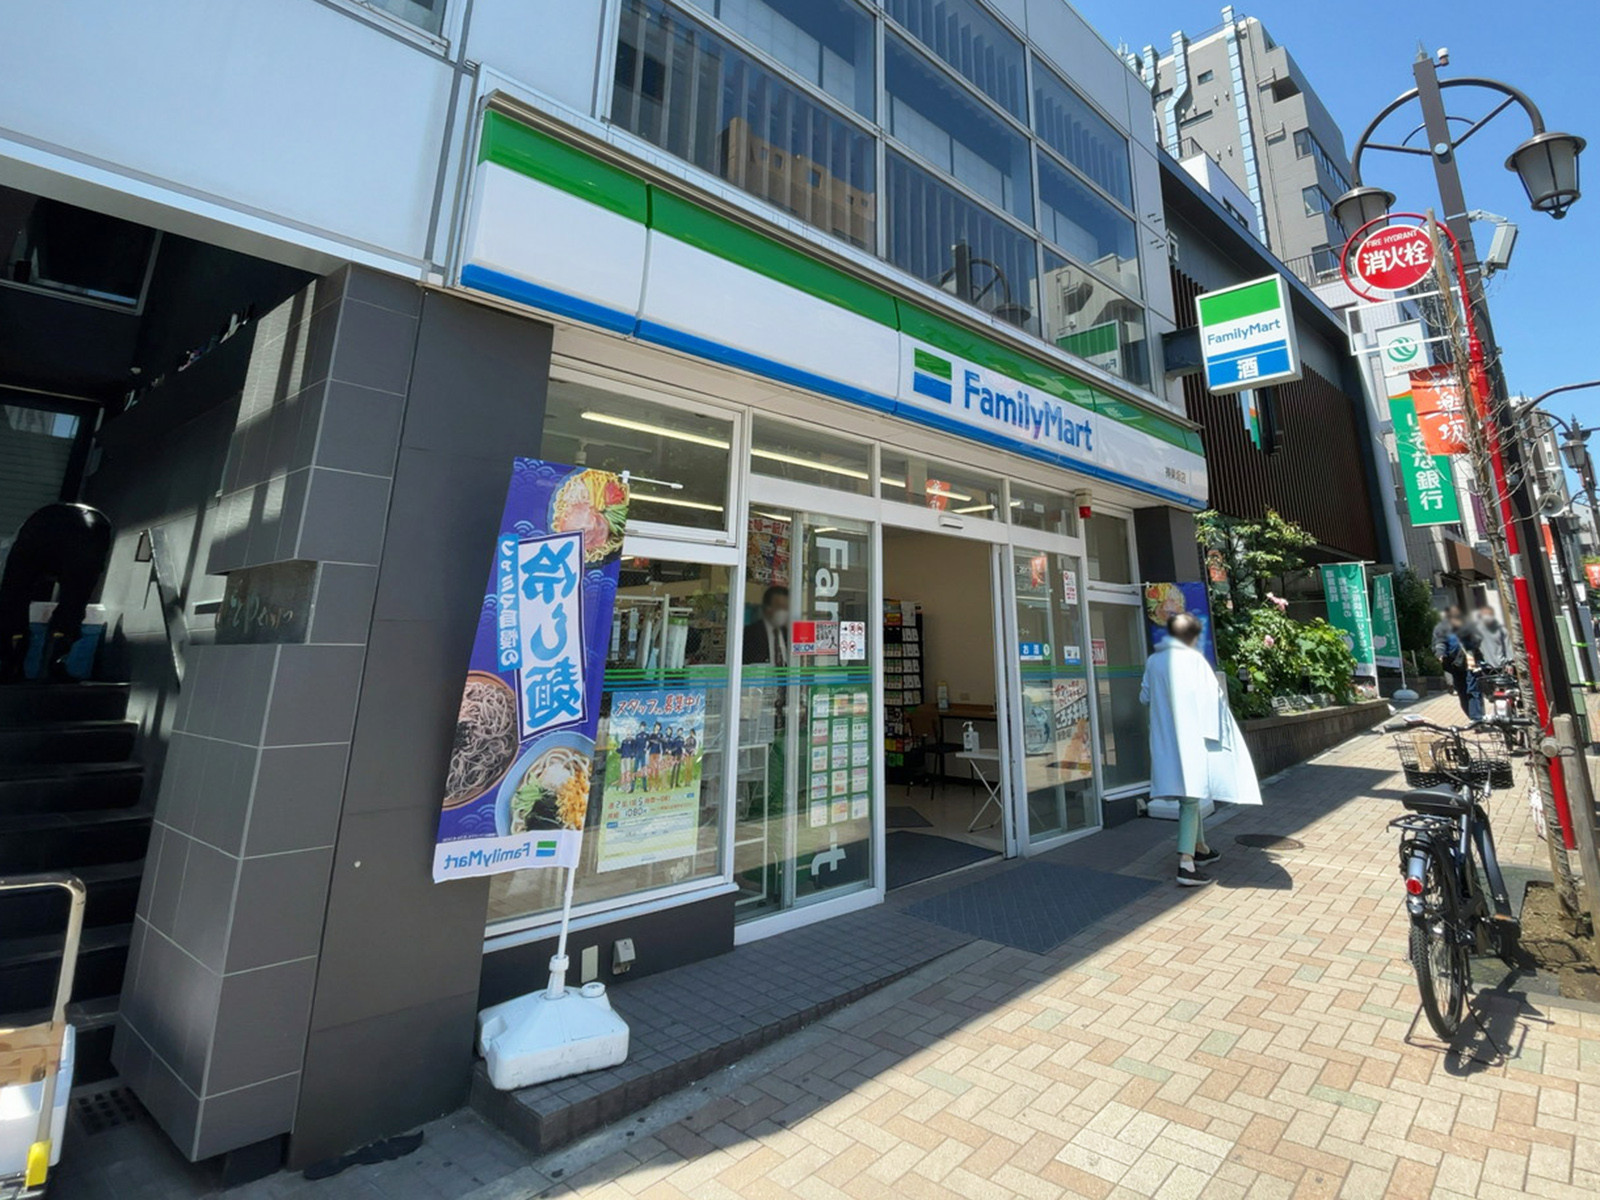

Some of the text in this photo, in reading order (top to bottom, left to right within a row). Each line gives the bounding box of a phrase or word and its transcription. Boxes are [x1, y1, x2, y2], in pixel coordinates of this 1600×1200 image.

[1366, 229, 1418, 248] FIRE HYDRANT
[1363, 240, 1429, 277] 消火栓
[1207, 318, 1281, 346] FamilyMart
[1236, 356, 1259, 379] 酒
[964, 369, 1093, 452] FamilyMart
